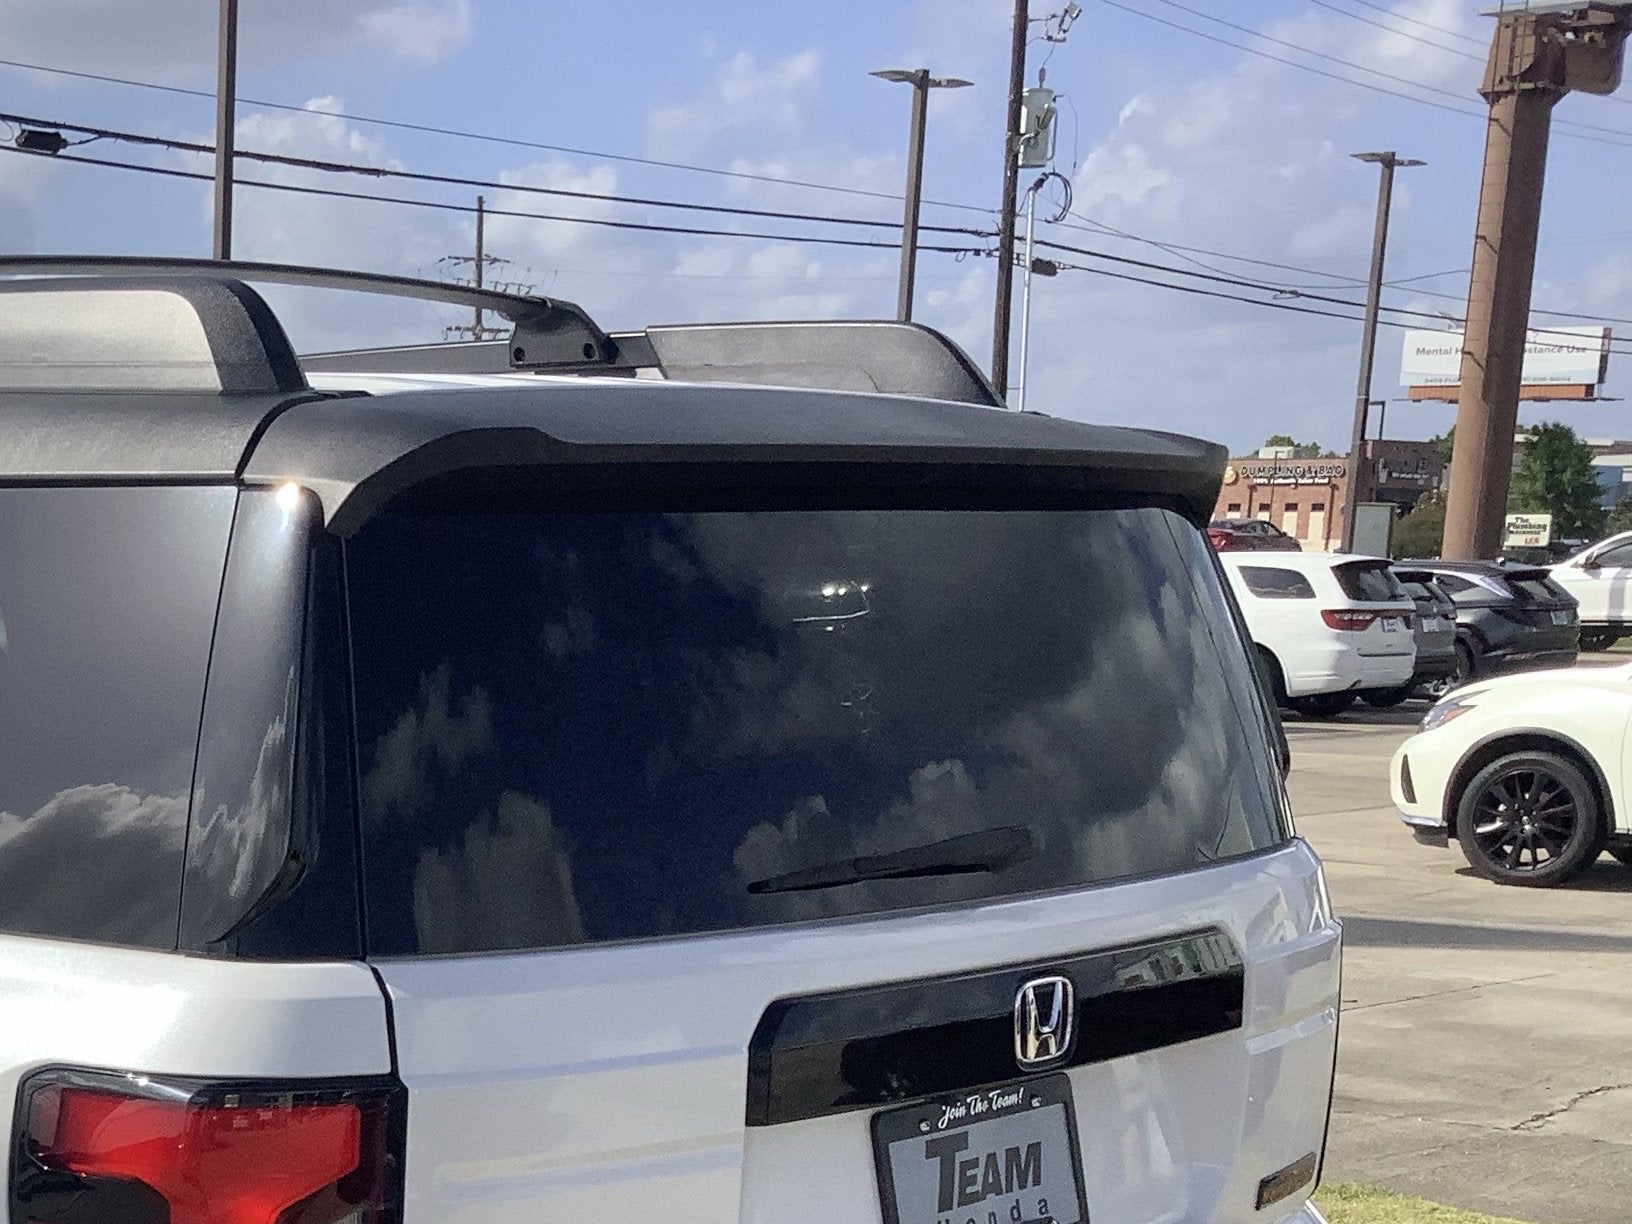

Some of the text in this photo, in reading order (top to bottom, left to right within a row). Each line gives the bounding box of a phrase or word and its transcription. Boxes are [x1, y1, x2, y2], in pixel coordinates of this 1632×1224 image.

[1415, 347, 1453, 356] Mental
[1523, 345, 1564, 355] stance
[1241, 464, 1302, 476] DUMPLING
[938, 1087, 1024, 1129] Join The Team!
[925, 1131, 1042, 1214] TEAM
